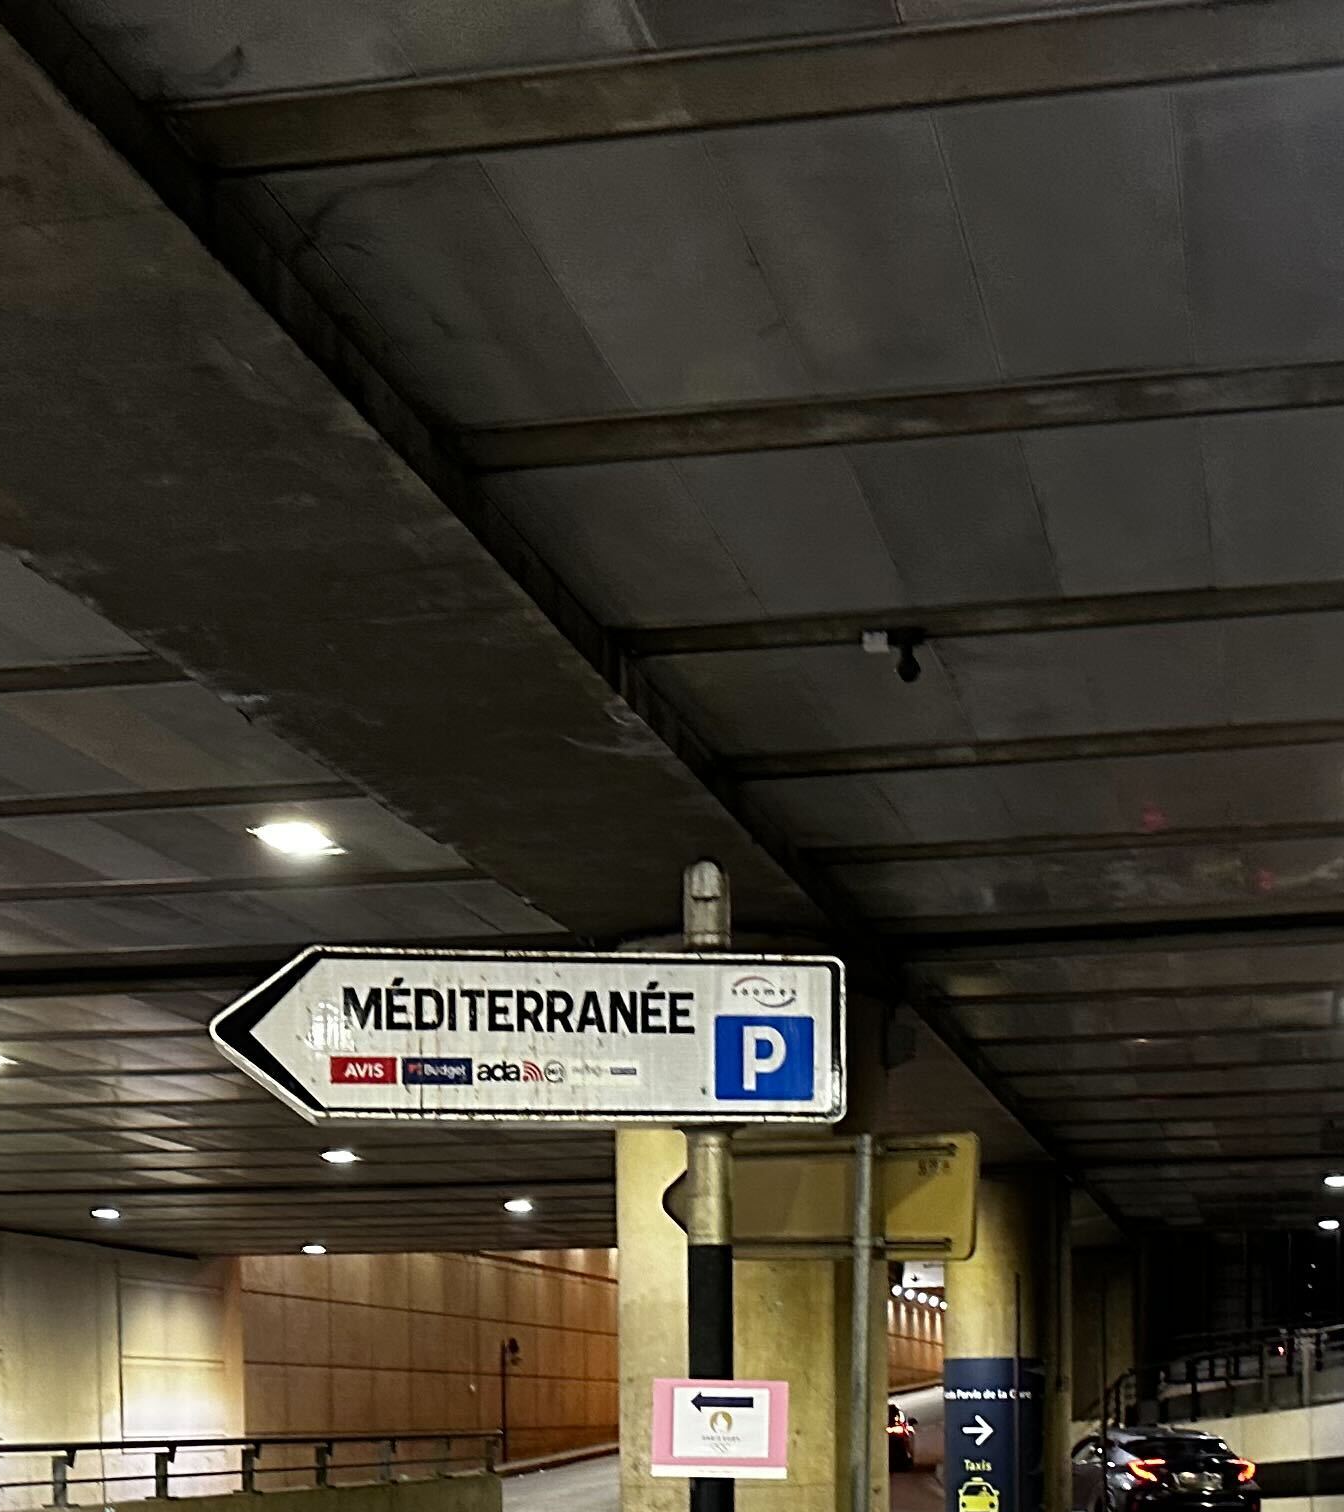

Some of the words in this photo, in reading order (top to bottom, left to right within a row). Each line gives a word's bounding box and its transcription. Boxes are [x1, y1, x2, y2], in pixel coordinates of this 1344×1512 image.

[342, 977, 696, 1035] MÉDITERRANÉE
[743, 1026, 787, 1091] P
[344, 1063, 385, 1079] AVIS
[424, 1063, 467, 1079] Budget
[477, 1060, 520, 1082] ada
[964, 1459, 992, 1471] Taxis
